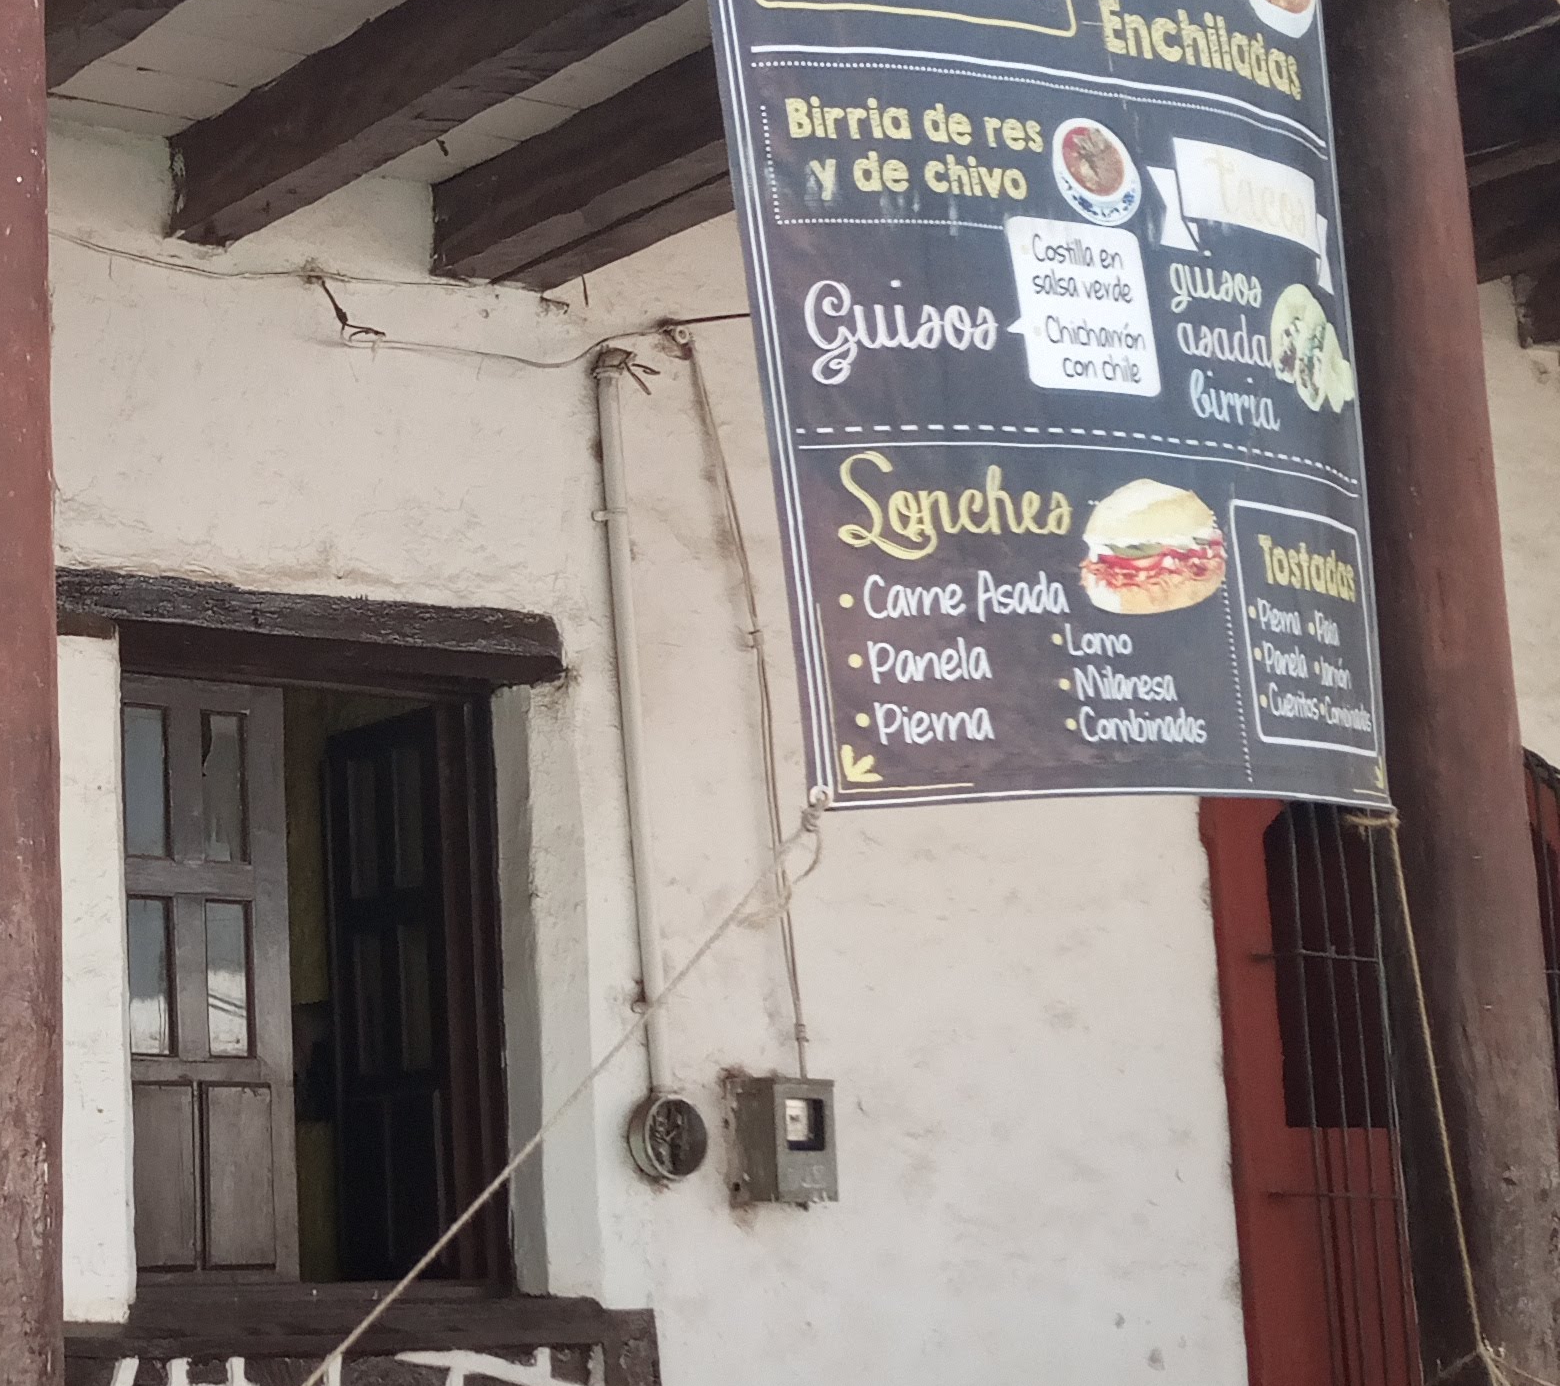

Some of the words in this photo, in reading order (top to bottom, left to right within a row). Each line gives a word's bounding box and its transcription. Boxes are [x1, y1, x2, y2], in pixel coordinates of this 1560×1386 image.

[784, 95, 913, 140] Birria
[923, 102, 973, 146] de
[983, 115, 1044, 153] res
[808, 158, 837, 201] y
[853, 150, 910, 193] de
[923, 153, 1028, 200] chivo
[1032, 233, 1095, 268] Costilla
[1099, 249, 1124, 270] en
[1032, 268, 1081, 298] salsa
[1083, 276, 1134, 304] verde
[1169, 249, 1262, 314] guisos
[803, 279, 1000, 386] Guisos
[1045, 315, 1147, 350] Chicharrón
[1177, 313, 1274, 369] asada
[1062, 357, 1098, 379] con
[1102, 354, 1142, 384] chile
[1189, 368, 1281, 433] birria
[1257, 533, 1356, 603] Tostadas
[863, 574, 967, 619] Carne
[977, 570, 1071, 623] Asada
[866, 636, 993, 685] Panela
[1064, 623, 1134, 657] Lomo
[1073, 664, 1178, 702] Milanesa
[873, 701, 995, 746] Pierna
